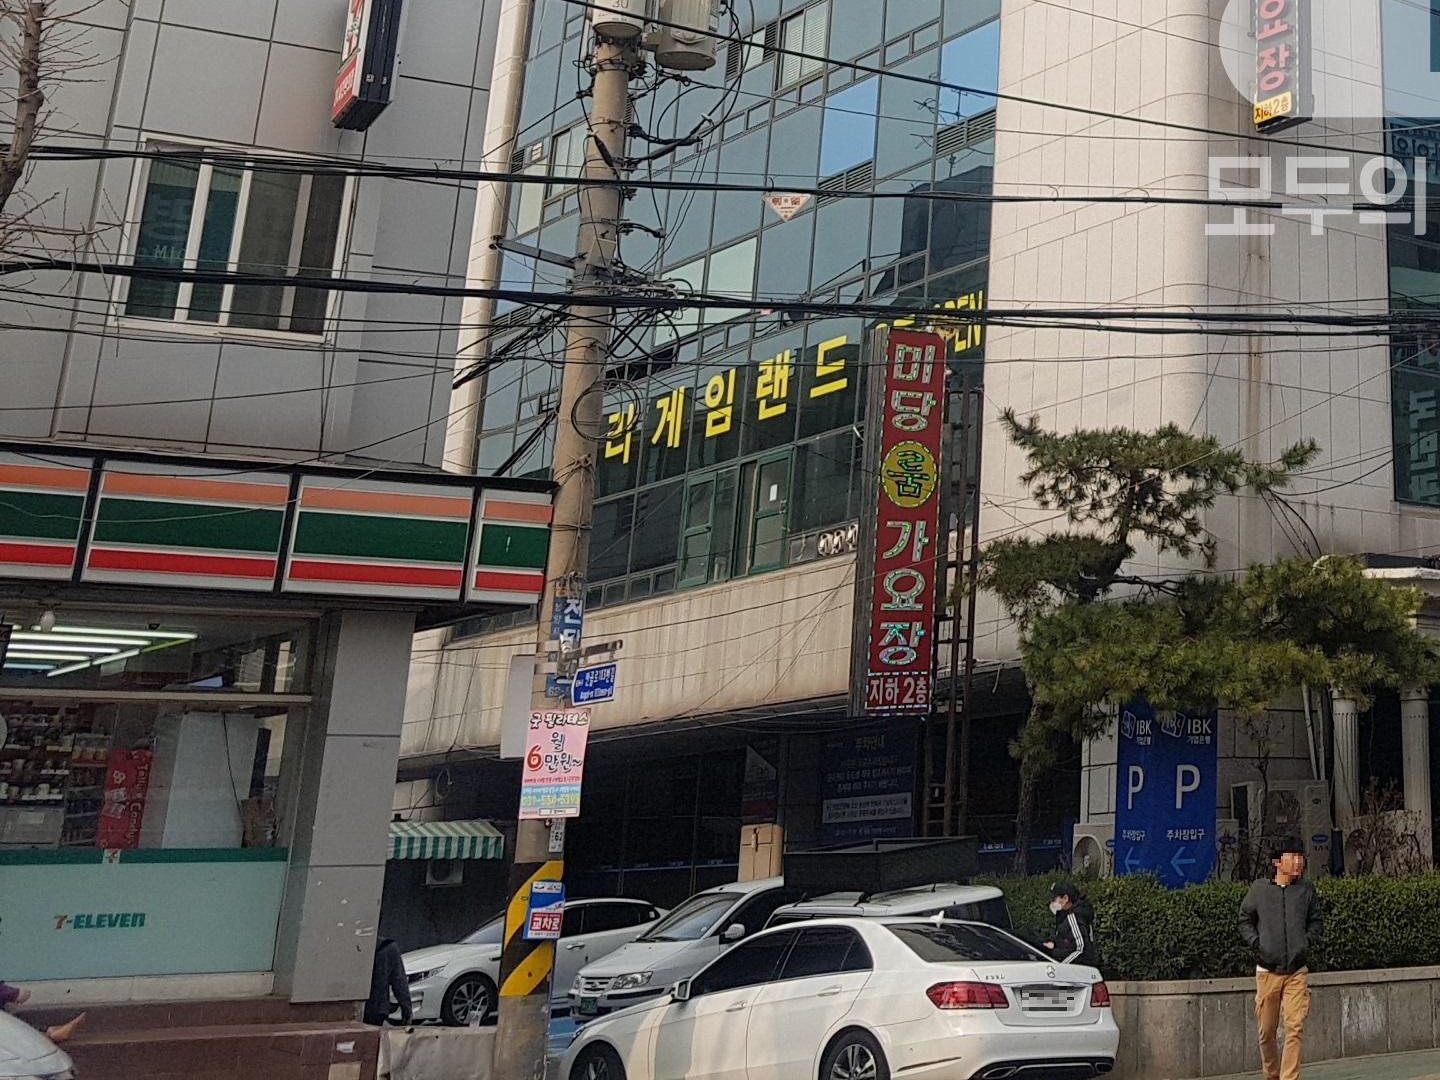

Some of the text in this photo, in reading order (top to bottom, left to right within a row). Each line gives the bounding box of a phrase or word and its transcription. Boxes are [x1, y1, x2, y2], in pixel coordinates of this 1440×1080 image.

[890, 343, 936, 432] 미당
[877, 519, 929, 668] 가요장
[544, 712, 588, 729] 필라테스
[1136, 720, 1153, 736] IBK
[1186, 718, 1213, 735] IBK
[1127, 765, 1145, 811] P
[1174, 763, 1201, 810] P
[1166, 828, 1207, 842] 주차장입구
